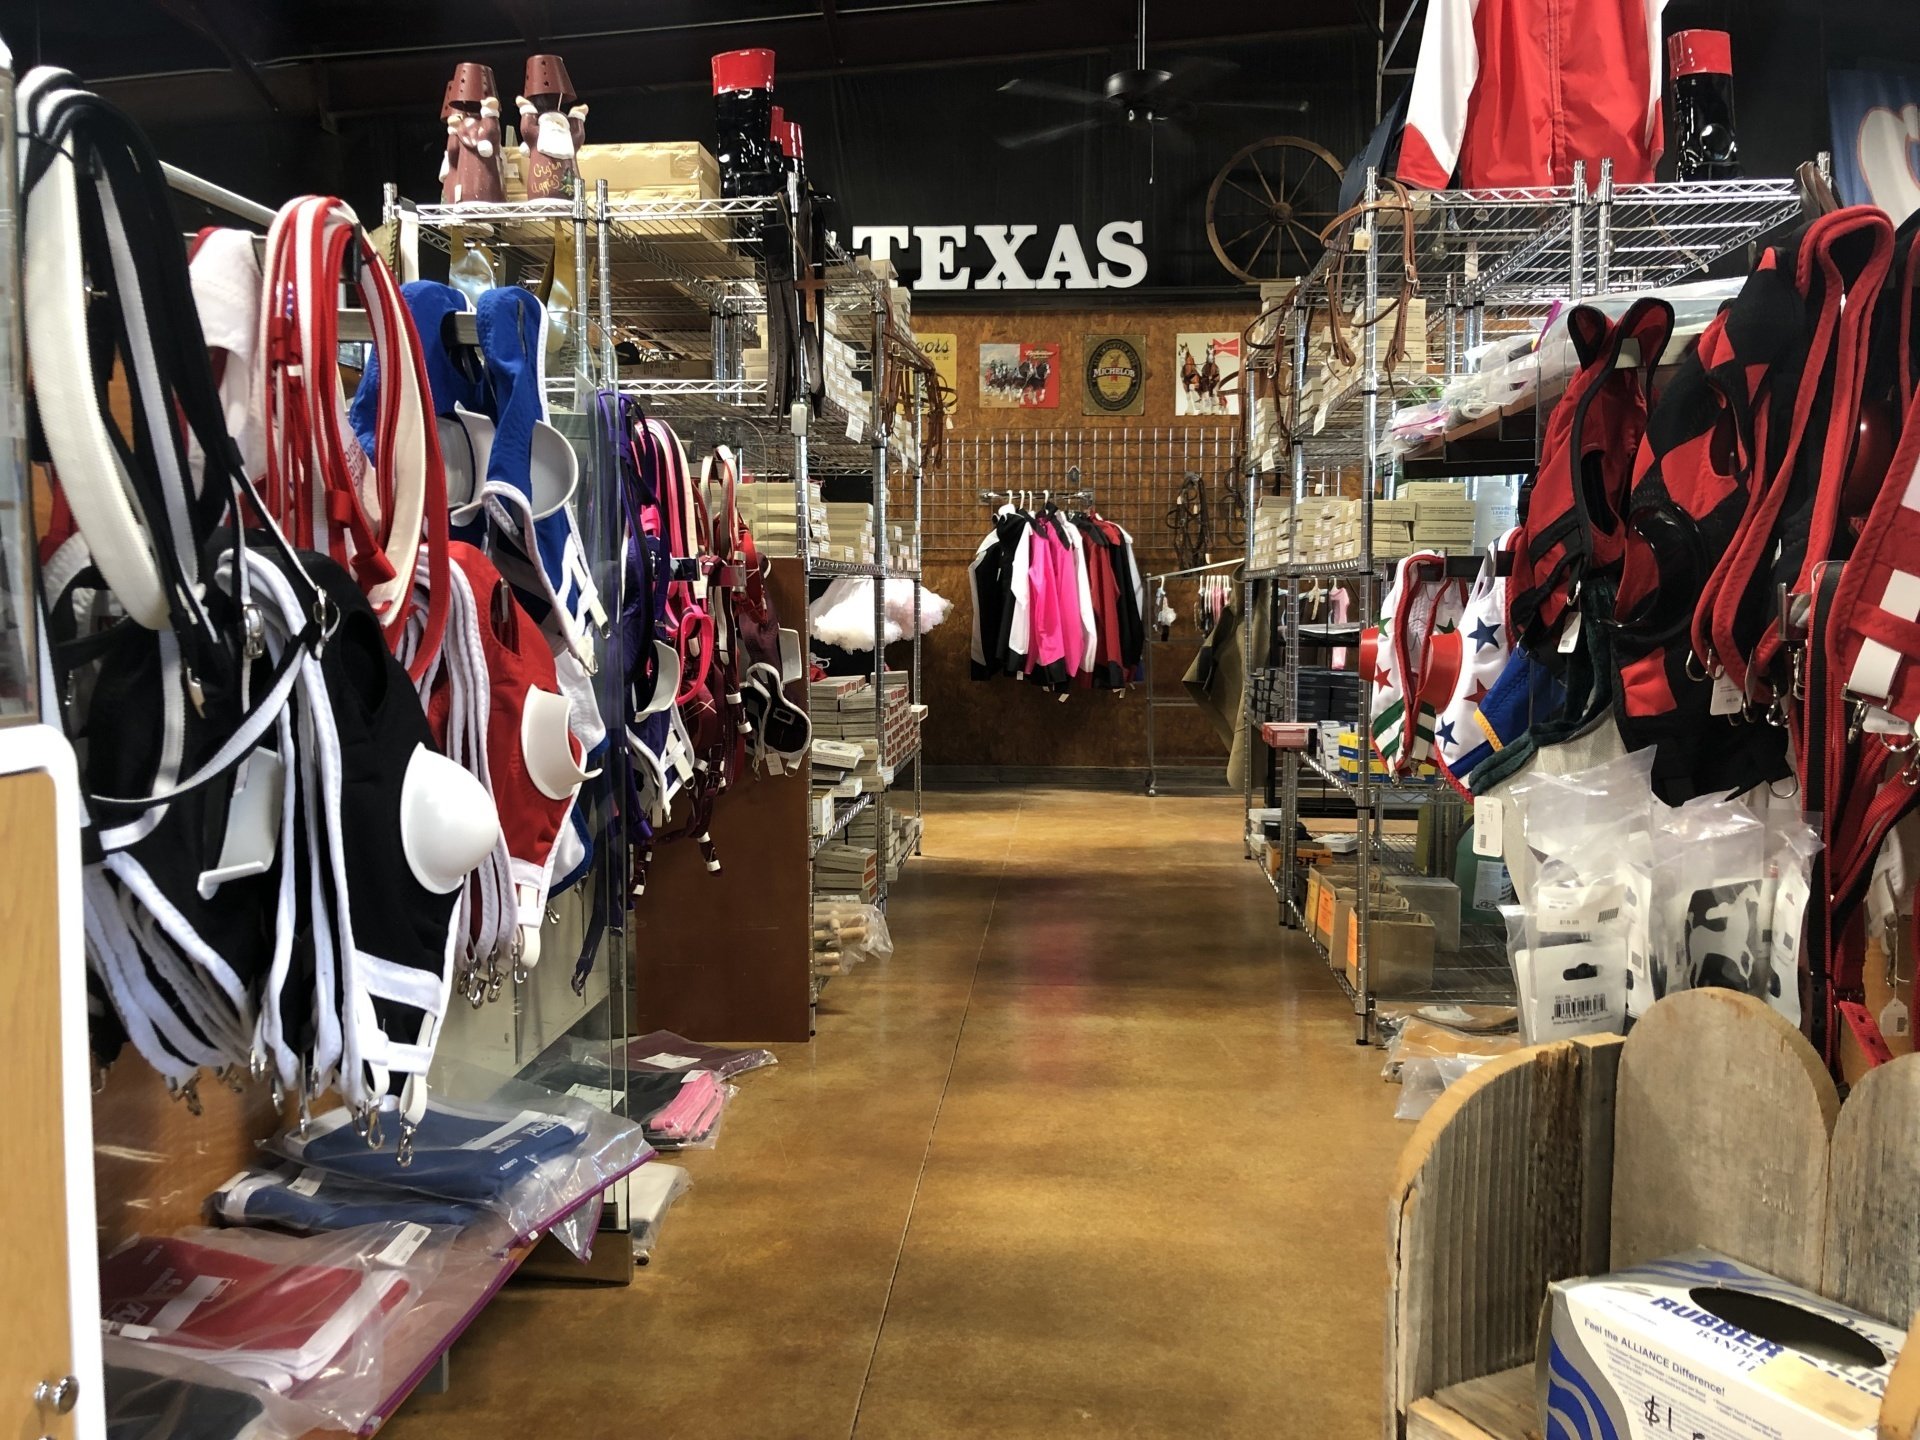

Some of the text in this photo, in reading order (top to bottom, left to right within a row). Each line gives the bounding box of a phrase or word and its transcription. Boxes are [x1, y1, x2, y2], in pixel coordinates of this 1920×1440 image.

[852, 220, 1148, 290] TEXAS
[916, 337, 949, 354] oors
[1092, 367, 1136, 378] MICHELOB
[1584, 1317, 1602, 1335] Feel
[1604, 1329, 1618, 1343] the
[1621, 1337, 1670, 1369] ALLIANCE
[1672, 1363, 1726, 1397] Difference!
[1650, 1296, 1785, 1359] RUBBER
